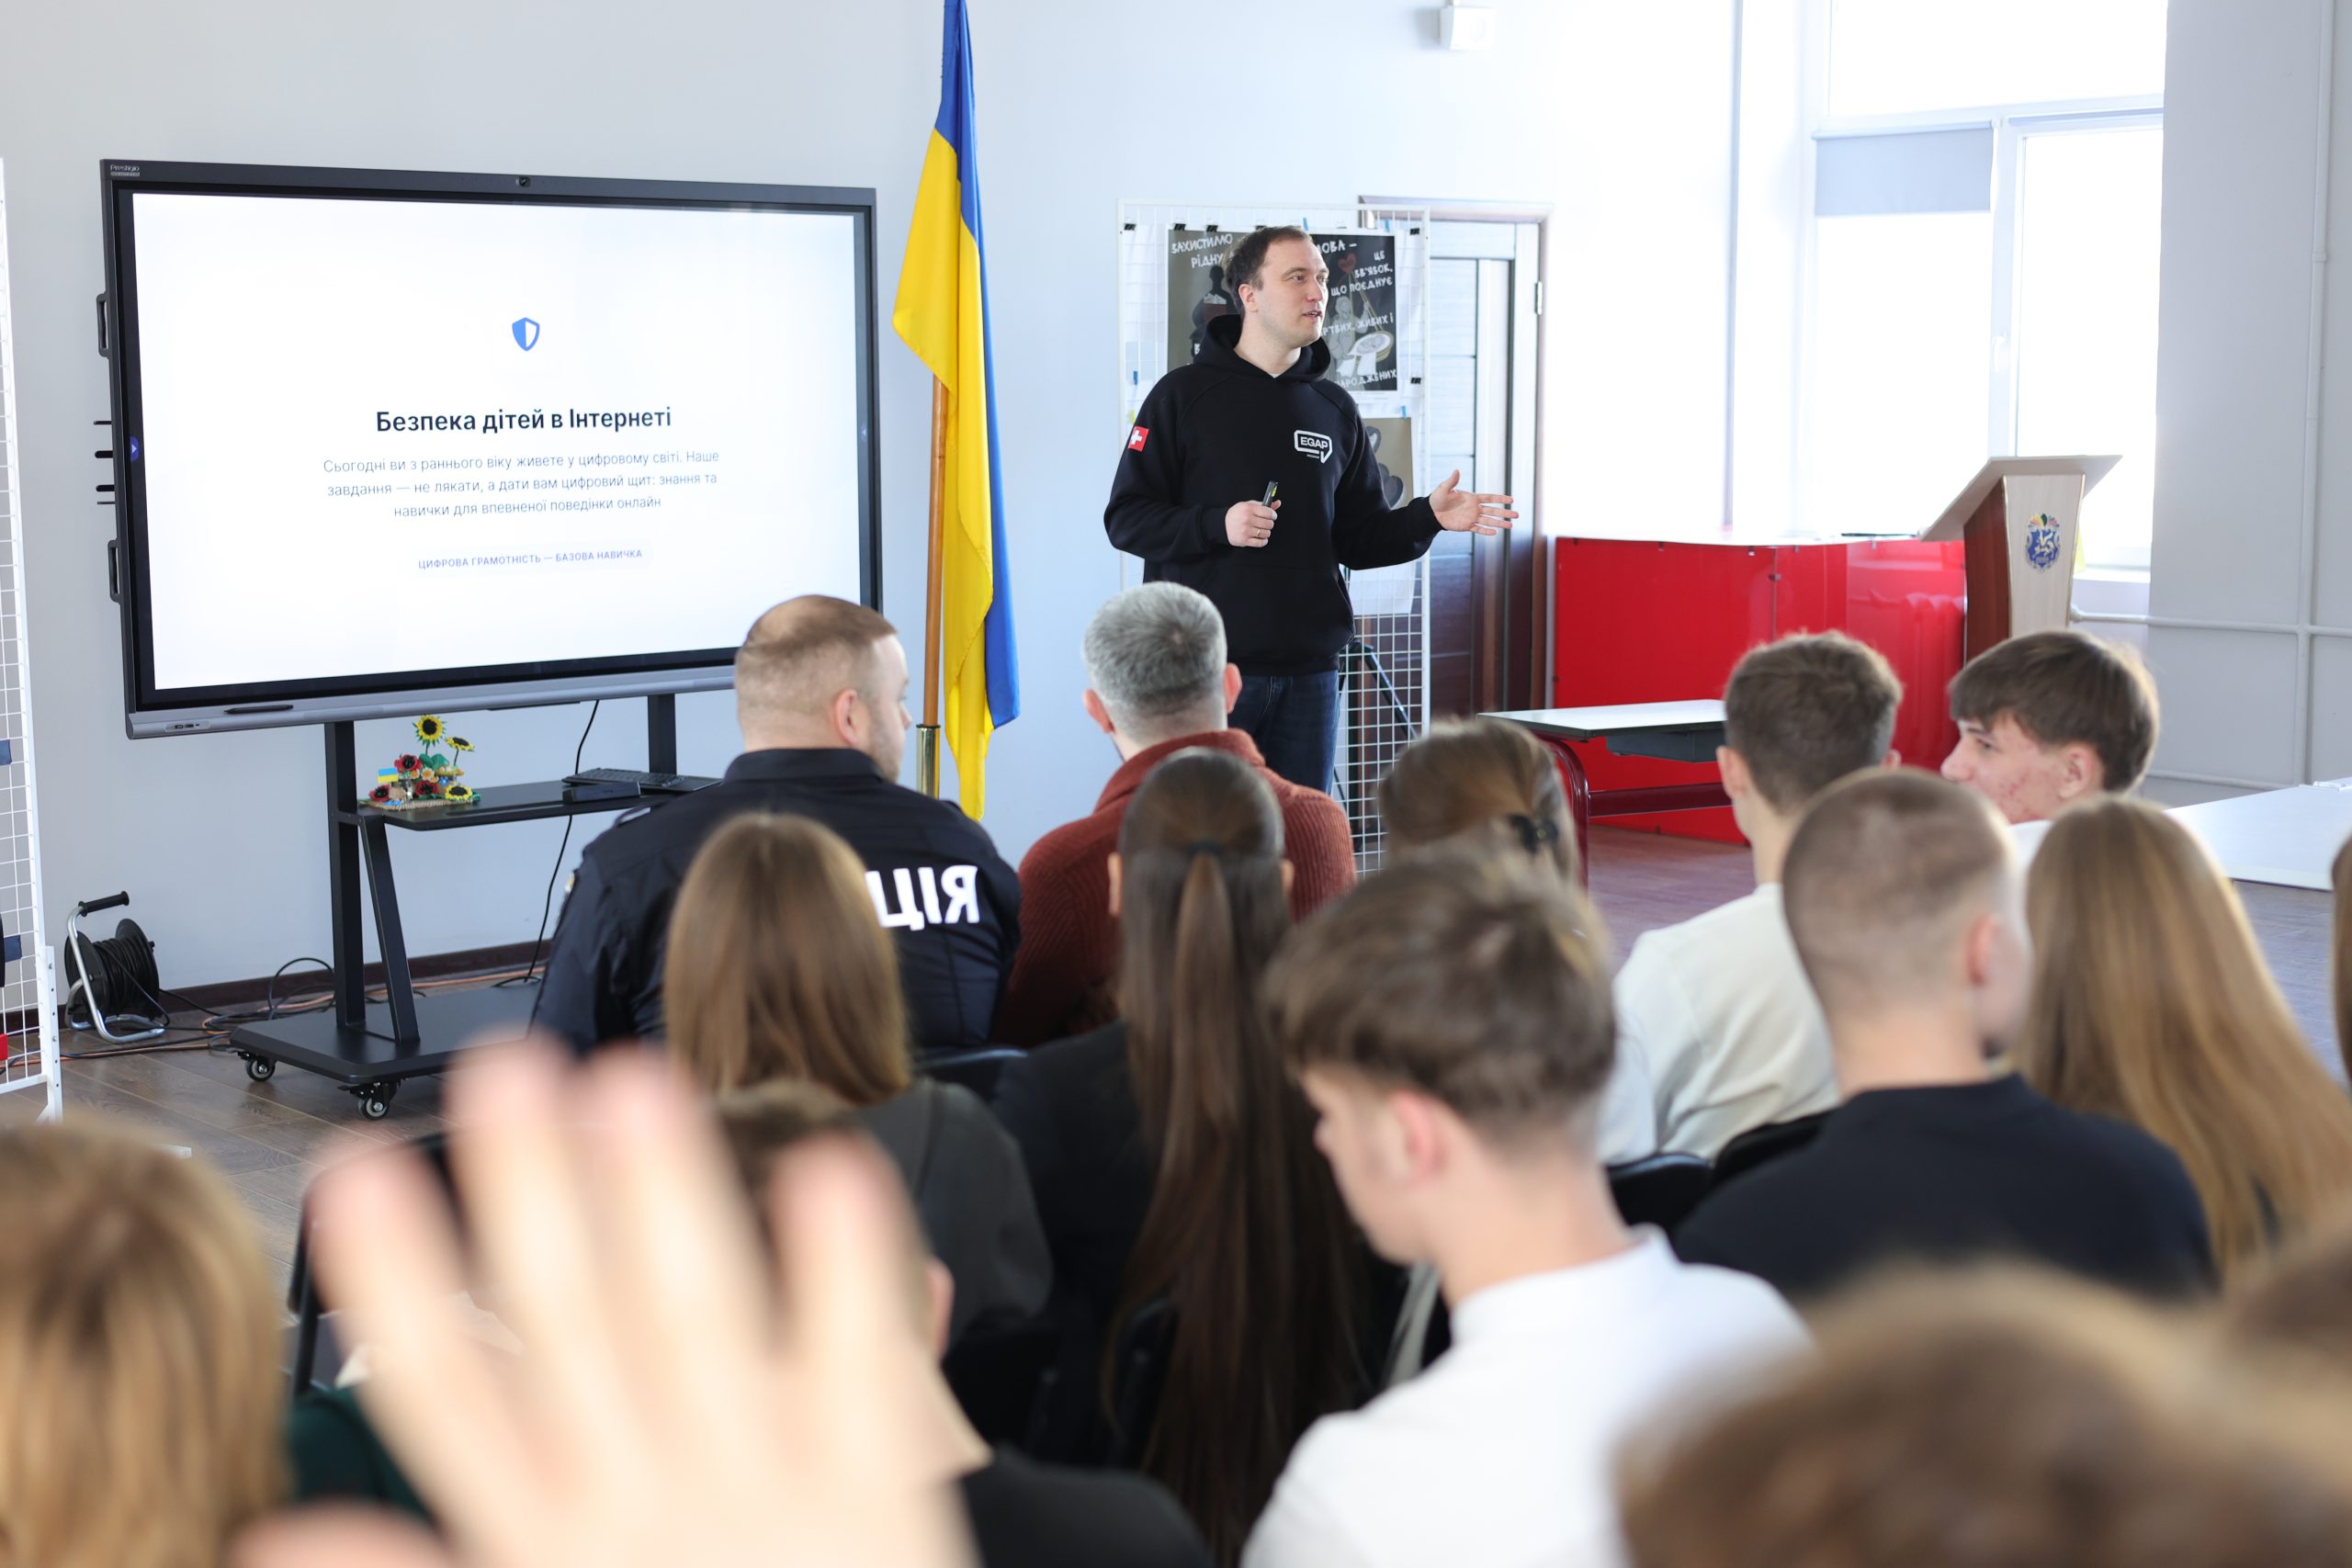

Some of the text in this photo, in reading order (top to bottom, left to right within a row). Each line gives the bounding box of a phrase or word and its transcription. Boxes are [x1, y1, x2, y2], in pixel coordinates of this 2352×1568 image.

[1170, 233, 1233, 254] ЗАХИСТИМО
[1374, 250, 1385, 262] ЦЕ
[1330, 276, 1393, 297] ЩО ПОЄДНУЄ
[1321, 322, 1355, 335] РТВИХ,
[1358, 314, 1388, 328] ЖИВИХ
[377, 406, 672, 434] Безпека дітей в Інтернеті
[1300, 436, 1329, 449] EGAP
[323, 451, 718, 473] Сьогодні ви з раннього віку живете у цифровому світі. Наше
[328, 484, 391, 497] завдання
[415, 482, 430, 493] не
[435, 482, 483, 493] лякати,
[488, 480, 494, 491] а
[500, 479, 528, 492] дати
[534, 479, 557, 490] вам
[561, 475, 624, 490] цифровий
[628, 475, 655, 487] щит:
[659, 474, 700, 485] знання
[705, 473, 717, 483] та
[394, 497, 661, 516] навички для впевненої поведінки онлайн
[419, 558, 469, 570] ЦИФРОВА
[471, 555, 541, 566] ГРАМОТНІСТЬ
[556, 551, 594, 561] БАЗОВА
[597, 549, 642, 559] НАВИЧКА
[865, 864, 980, 931] ЦІЯ
